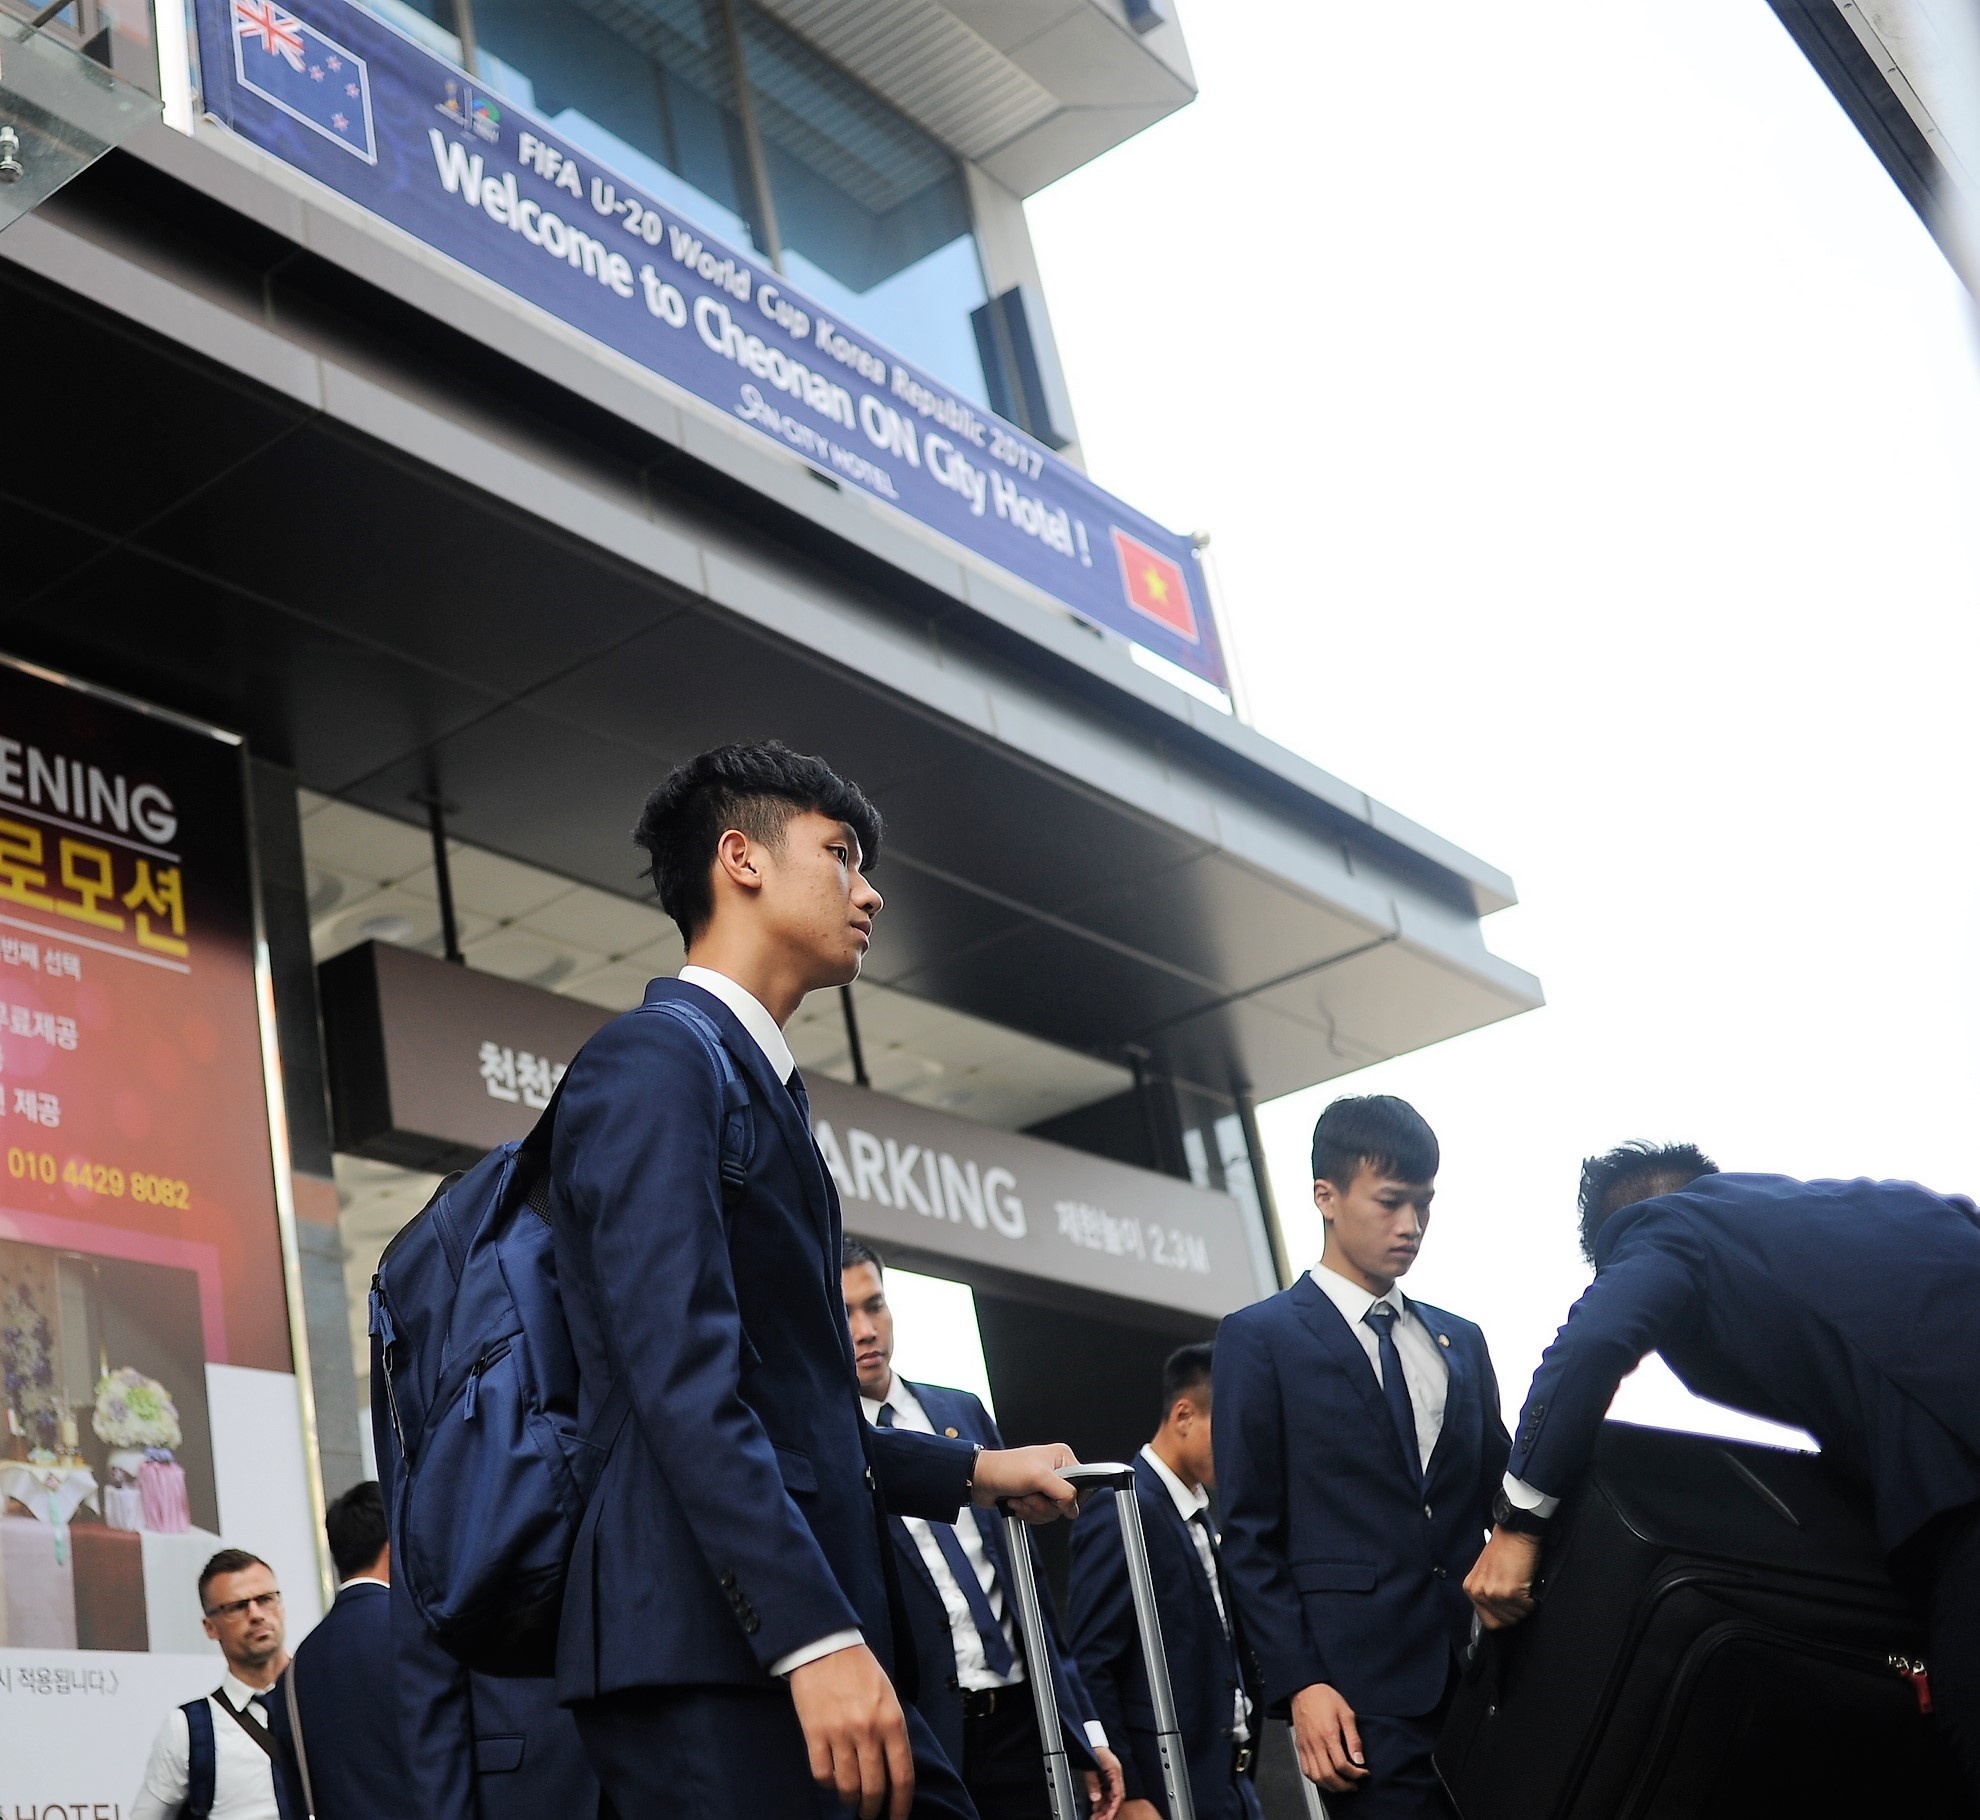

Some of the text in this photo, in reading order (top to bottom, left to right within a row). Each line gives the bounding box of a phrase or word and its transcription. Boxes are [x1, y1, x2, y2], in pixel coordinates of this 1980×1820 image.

[428, 127, 635, 298] Welcome
[639, 264, 688, 329] to
[693, 295, 857, 431] Cheonan
[859, 393, 921, 469] ON
[923, 432, 987, 516] City
[988, 469, 1075, 557] Hotel
[518, 131, 1044, 480] FIFA U-20 World Cup Korea Republic 2017
[0, 735, 178, 844] ENING
[0, 818, 190, 958] 로모션
[7, 1146, 191, 1211] 010 4429 8082
